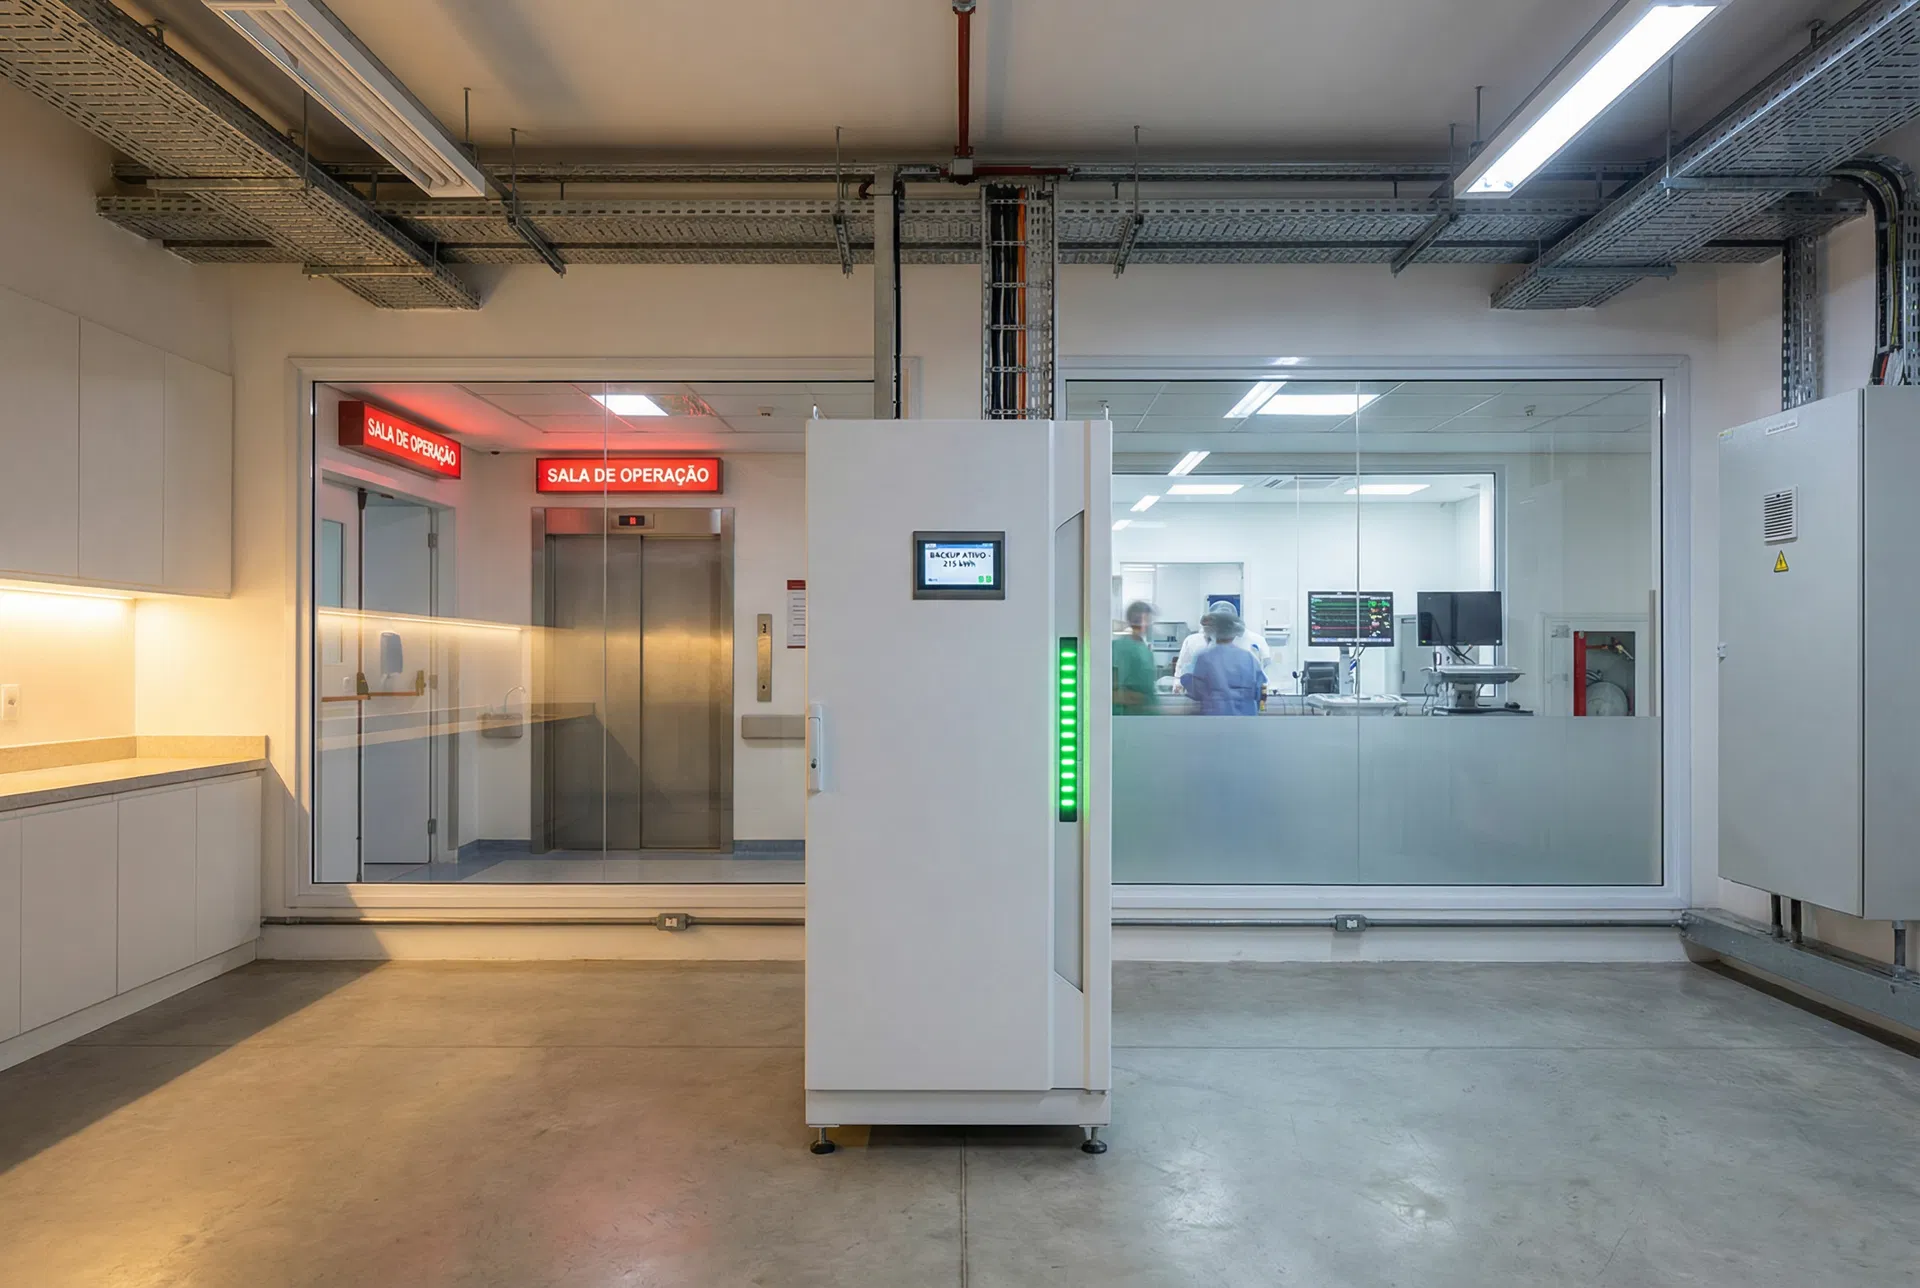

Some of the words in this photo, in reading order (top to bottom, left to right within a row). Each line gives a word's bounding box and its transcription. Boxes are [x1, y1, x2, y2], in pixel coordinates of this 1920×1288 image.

[368, 417, 395, 444] SALA
[396, 428, 409, 449] DE
[410, 435, 456, 466] OPERAÇÃO
[547, 467, 590, 483] SALA
[594, 467, 617, 483] DE
[620, 464, 710, 486] OPERAÇÃO
[930, 551, 960, 559] BACKUP
[962, 551, 987, 559] ATIVO
